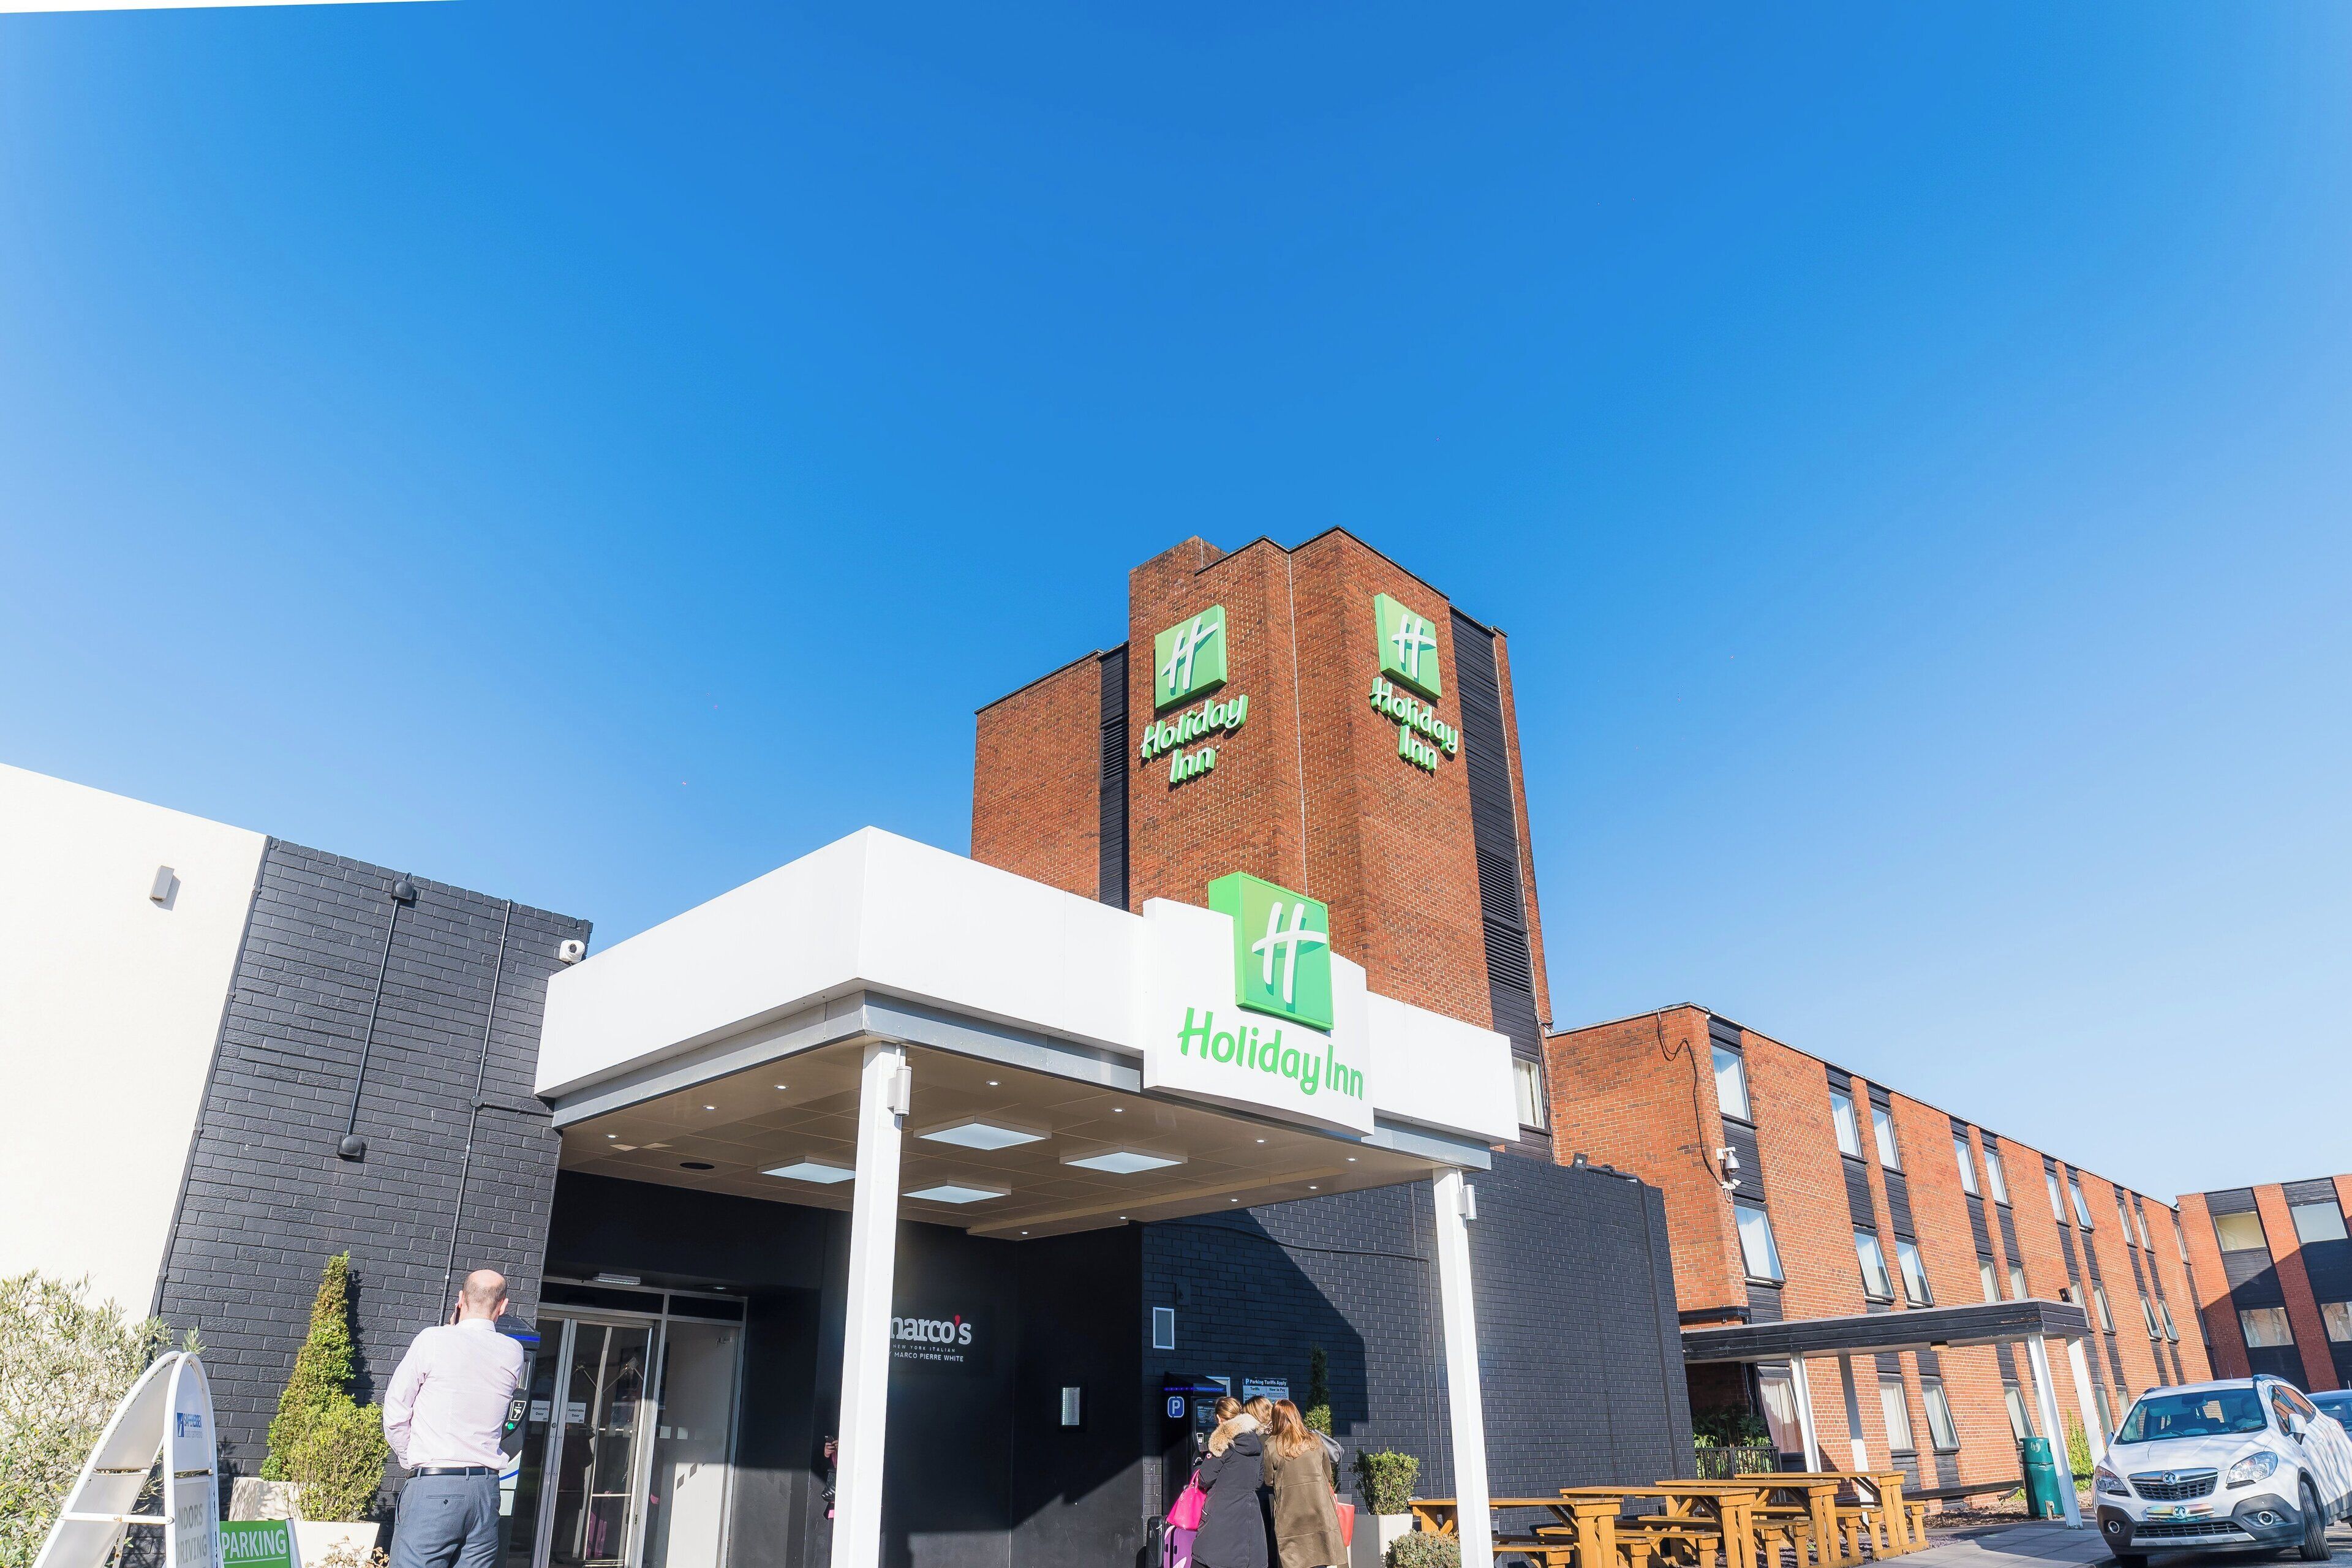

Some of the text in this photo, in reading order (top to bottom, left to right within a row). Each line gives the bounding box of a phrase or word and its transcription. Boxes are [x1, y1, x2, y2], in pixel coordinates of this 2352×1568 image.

[1139, 694, 1249, 760] Holiday
[1369, 677, 1459, 756] Holiday
[1170, 747, 1216, 784] Inn
[1398, 725, 1439, 772] Inn
[1177, 1006, 1363, 1101] Holiday Inn
[1172, 1400, 1180, 1414] P
[178, 1503, 203, 1531] NDORS
[176, 1534, 207, 1566] DRIVING
[221, 1529, 287, 1559] PARKING
